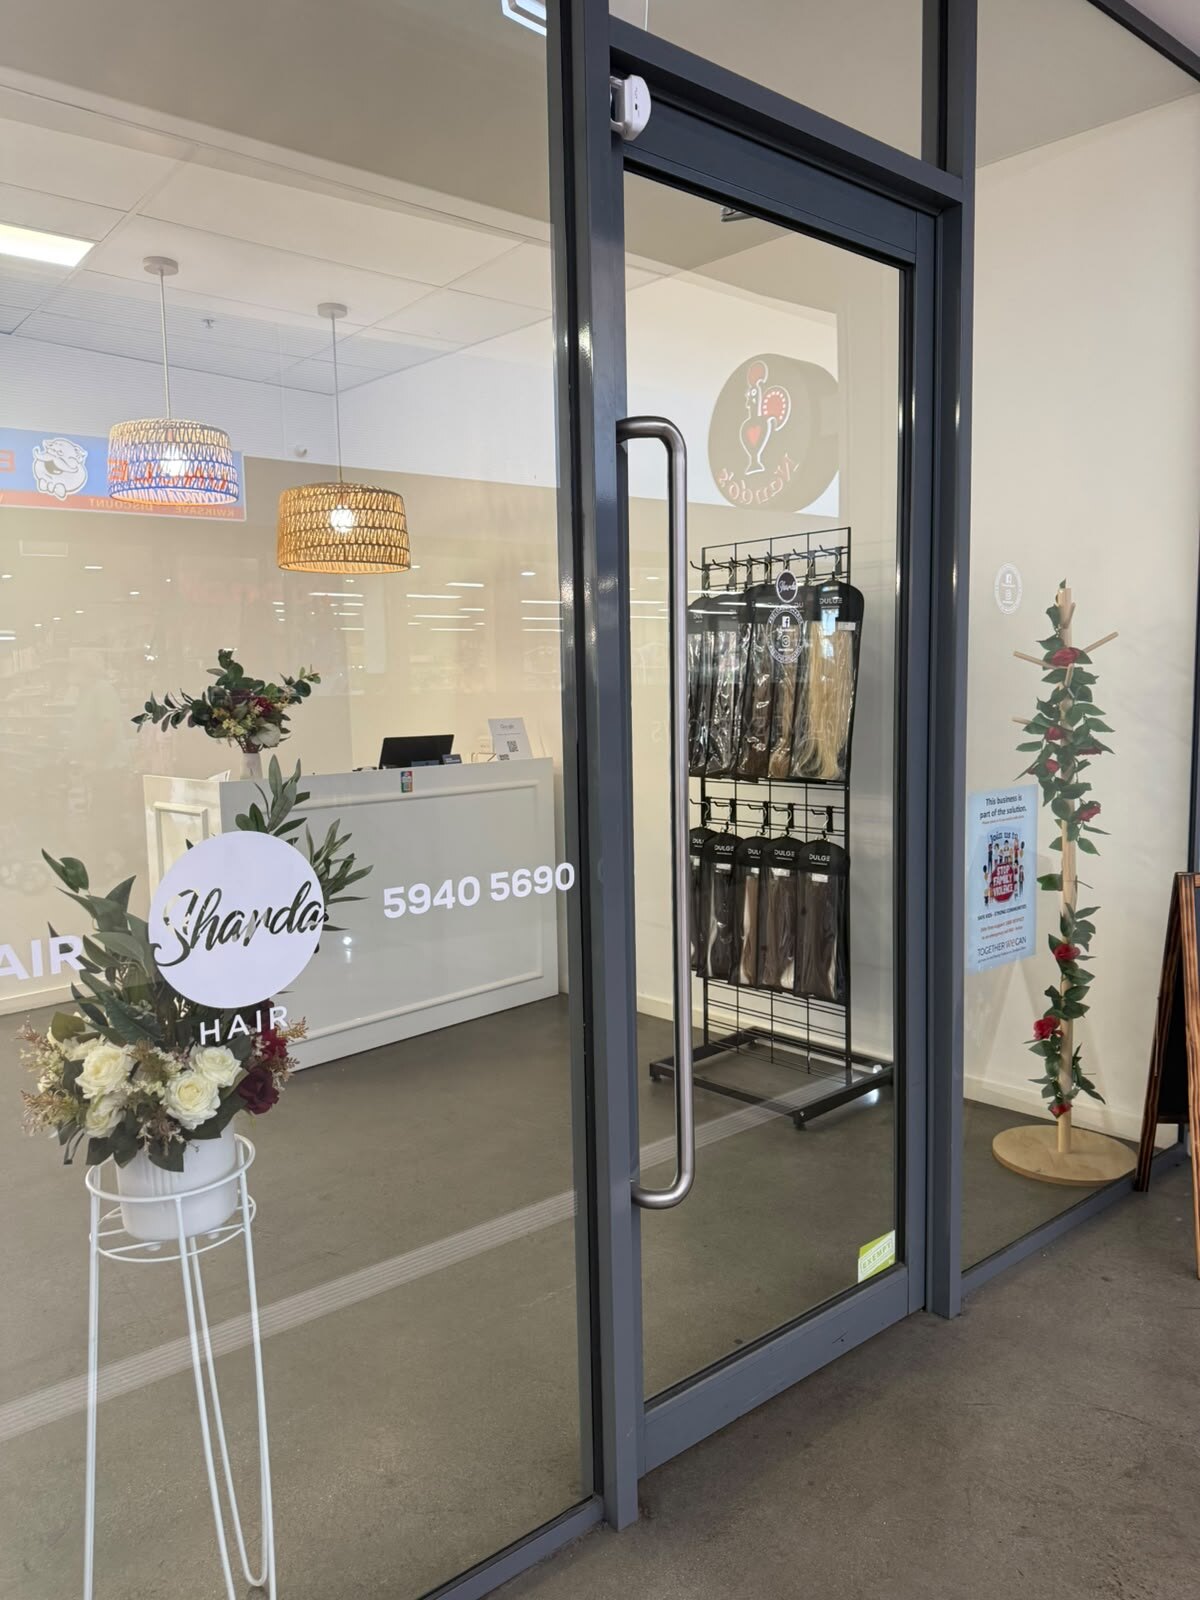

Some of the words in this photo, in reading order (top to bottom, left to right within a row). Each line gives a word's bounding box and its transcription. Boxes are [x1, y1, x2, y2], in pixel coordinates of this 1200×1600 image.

[986, 797, 996, 806] This
[997, 795, 1017, 804] business
[980, 811, 991, 820] part
[991, 809, 996, 817] of
[990, 831, 1003, 842] Join
[383, 876, 480, 919] 5940
[490, 862, 575, 902] 5690
[200, 1006, 289, 1046] HAIR
